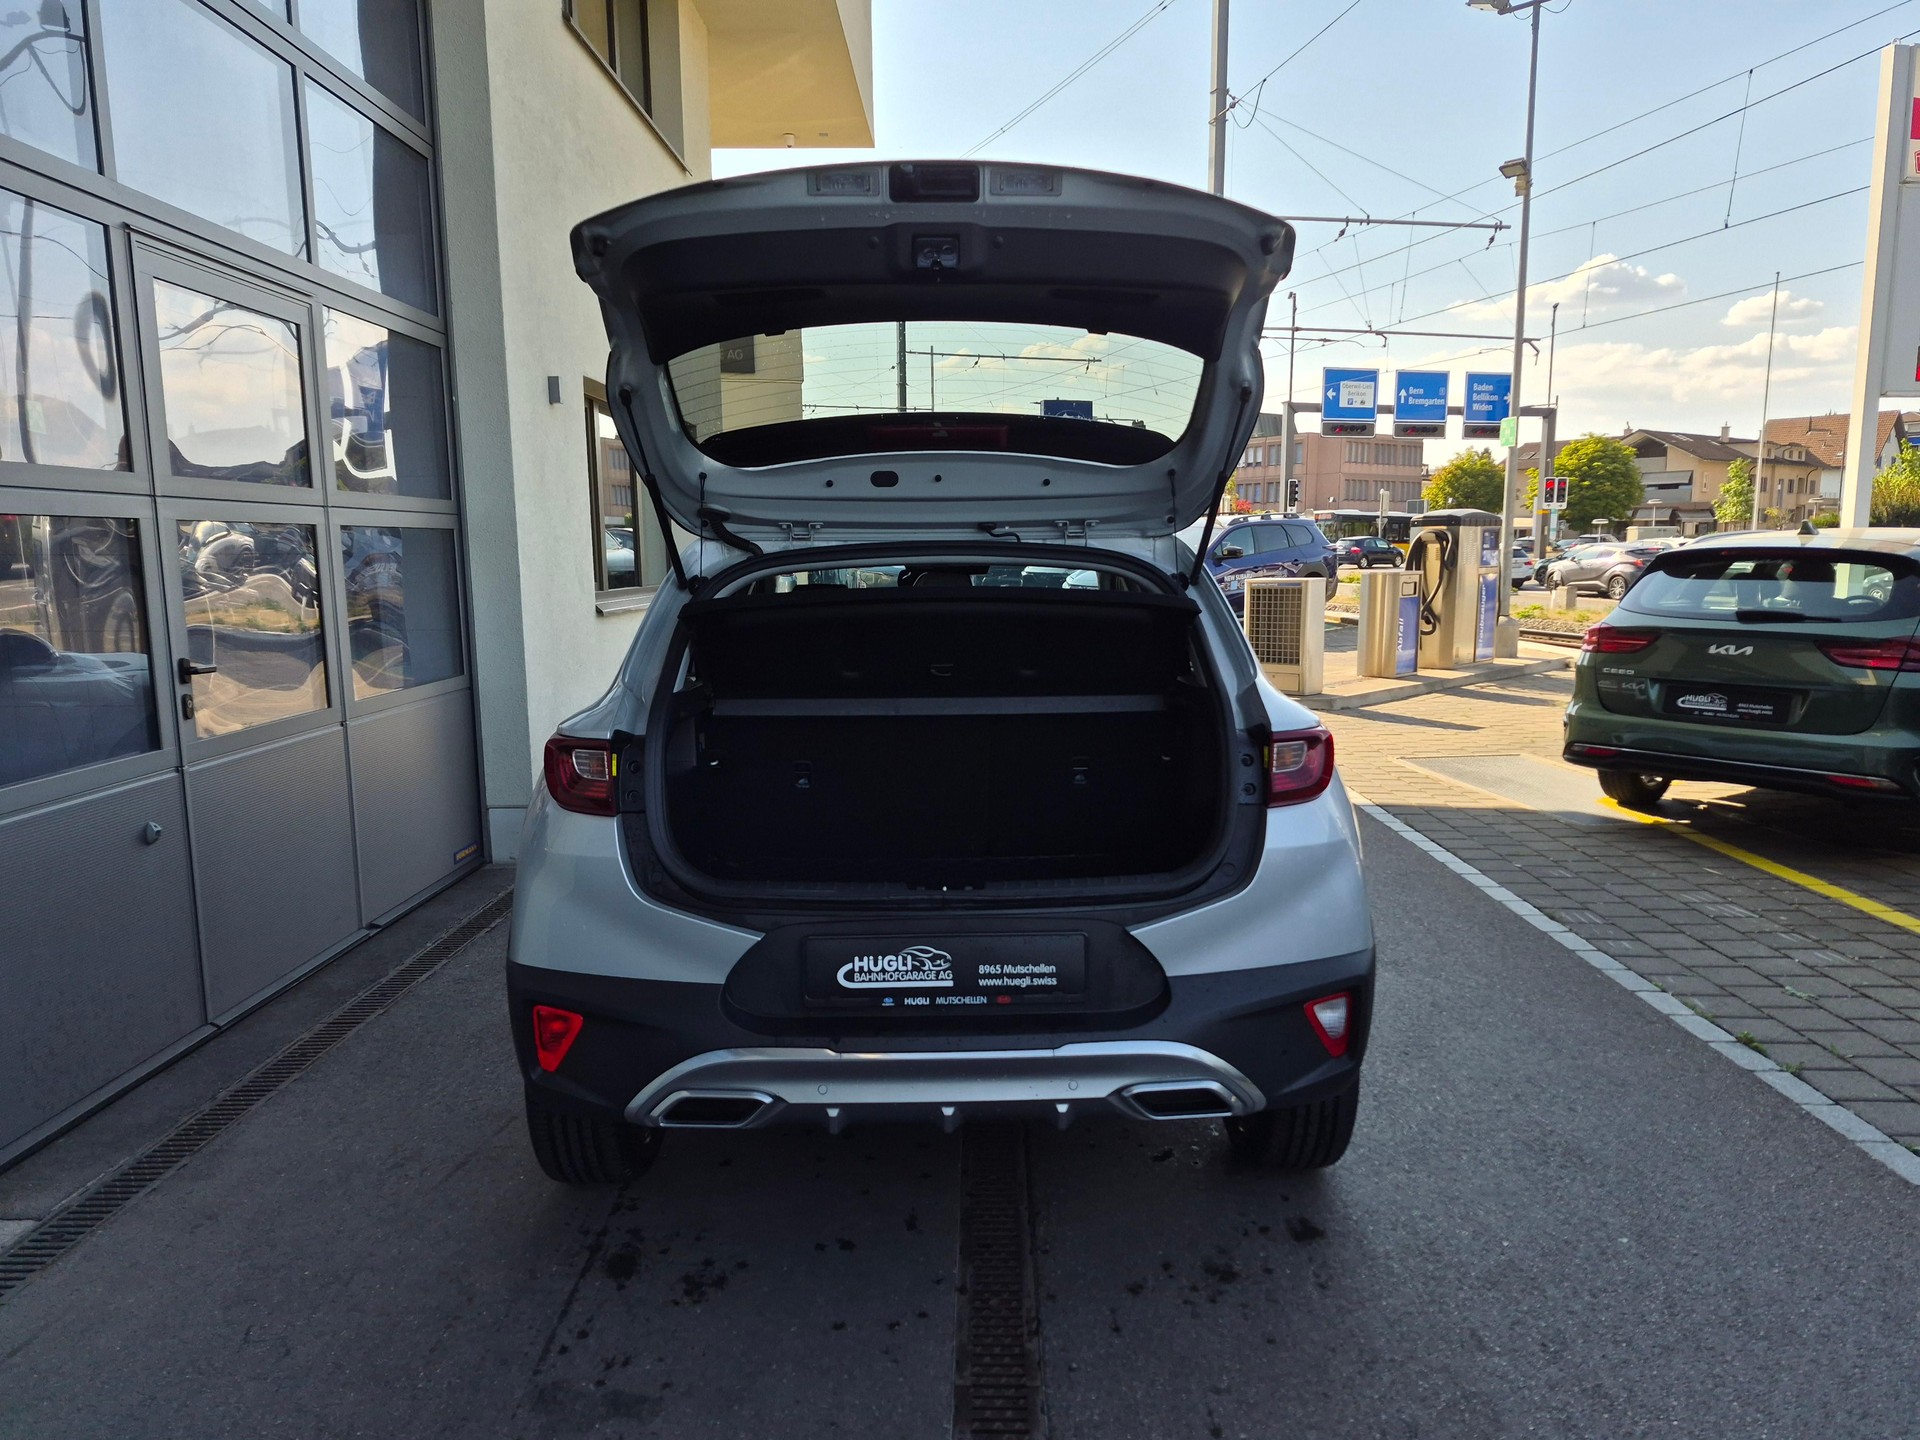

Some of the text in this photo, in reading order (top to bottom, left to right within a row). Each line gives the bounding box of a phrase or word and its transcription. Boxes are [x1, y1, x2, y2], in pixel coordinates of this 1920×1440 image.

[727, 349, 744, 360] AG
[1408, 386, 1424, 395] Bern
[1473, 382, 1494, 391] Baden
[1408, 396, 1445, 407] Bremgarten
[1472, 402, 1493, 411] Widen
[1709, 644, 1753, 656] KIA
[854, 954, 912, 972] HÜGLI
[978, 963, 1056, 974] 8965 Mutschellen
[854, 970, 953, 981] BAHNHOFGARAGE AG
[978, 976, 1057, 988] www.huegli.swiss
[935, 995, 987, 1005] MUTSCHELLEN
